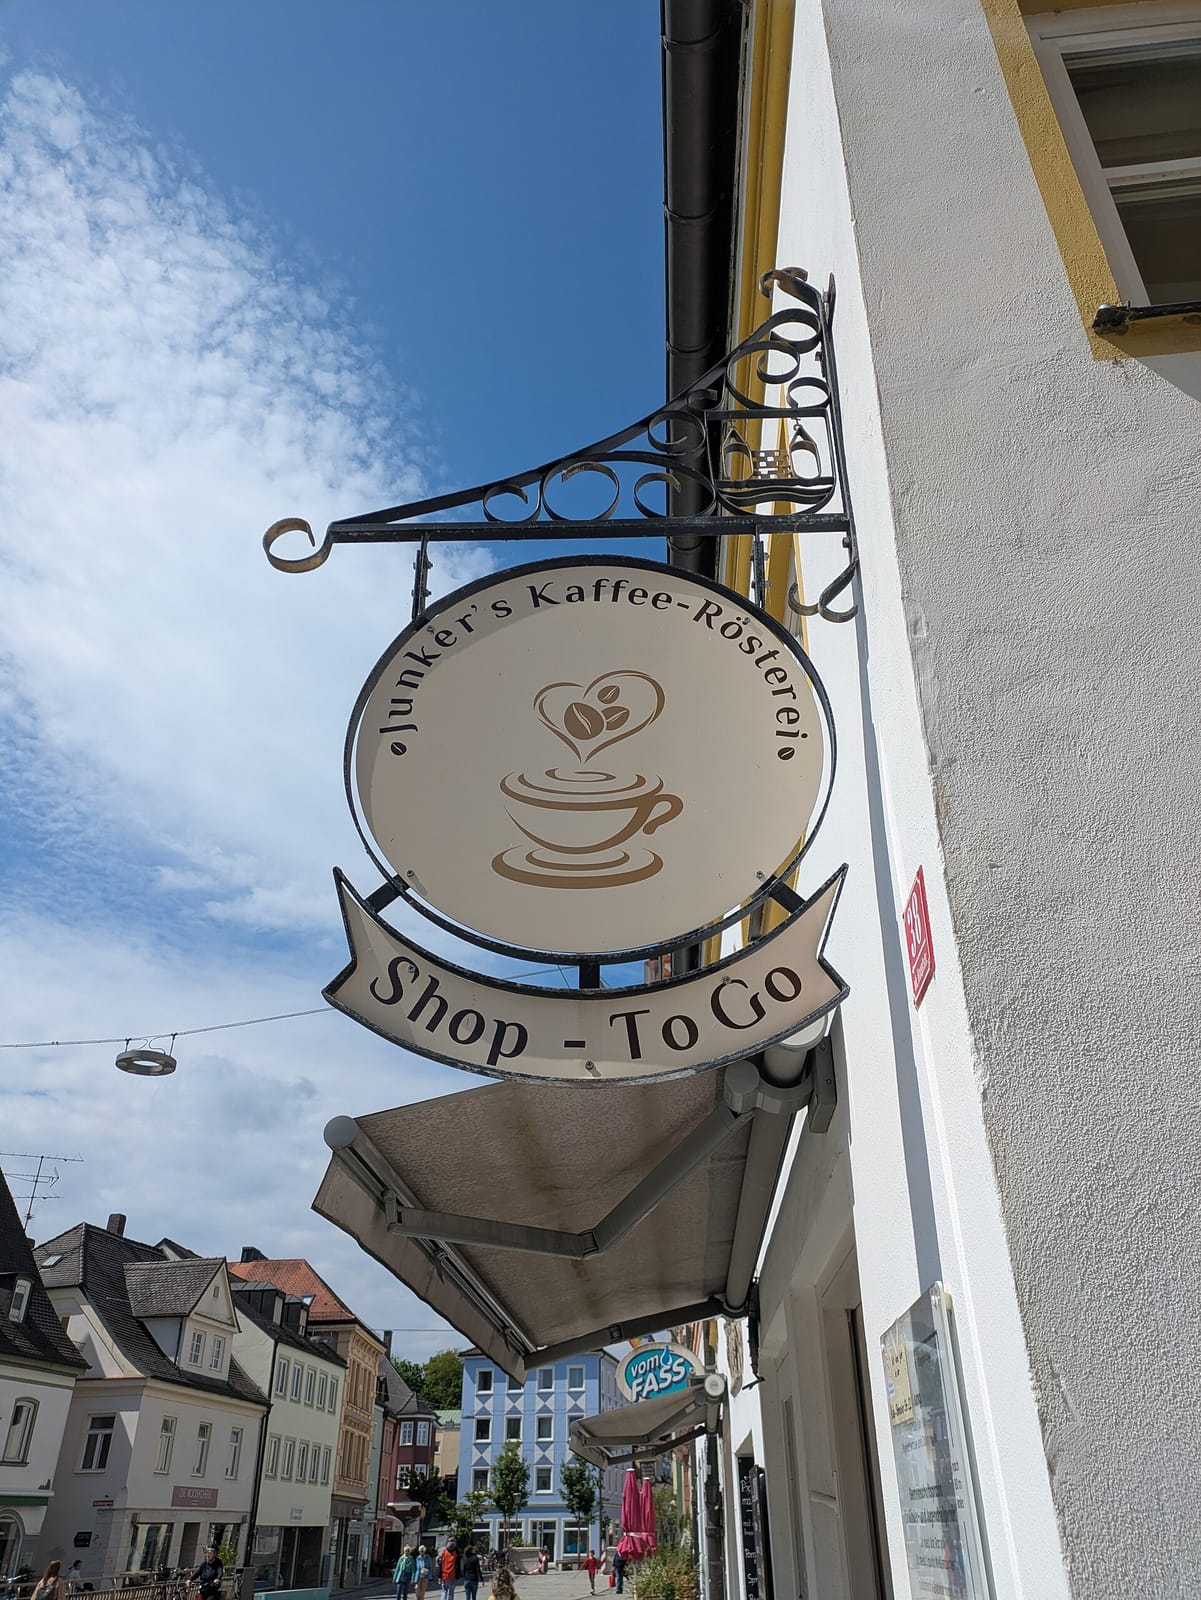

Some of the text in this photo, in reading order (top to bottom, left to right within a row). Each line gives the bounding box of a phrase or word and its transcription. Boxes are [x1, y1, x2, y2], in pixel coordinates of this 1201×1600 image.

[526, 577, 809, 739] Kaffee-Rösterei
[369, 955, 529, 1066] Shop
[630, 1355, 659, 1377] vom
[631, 1357, 686, 1403] FASS
